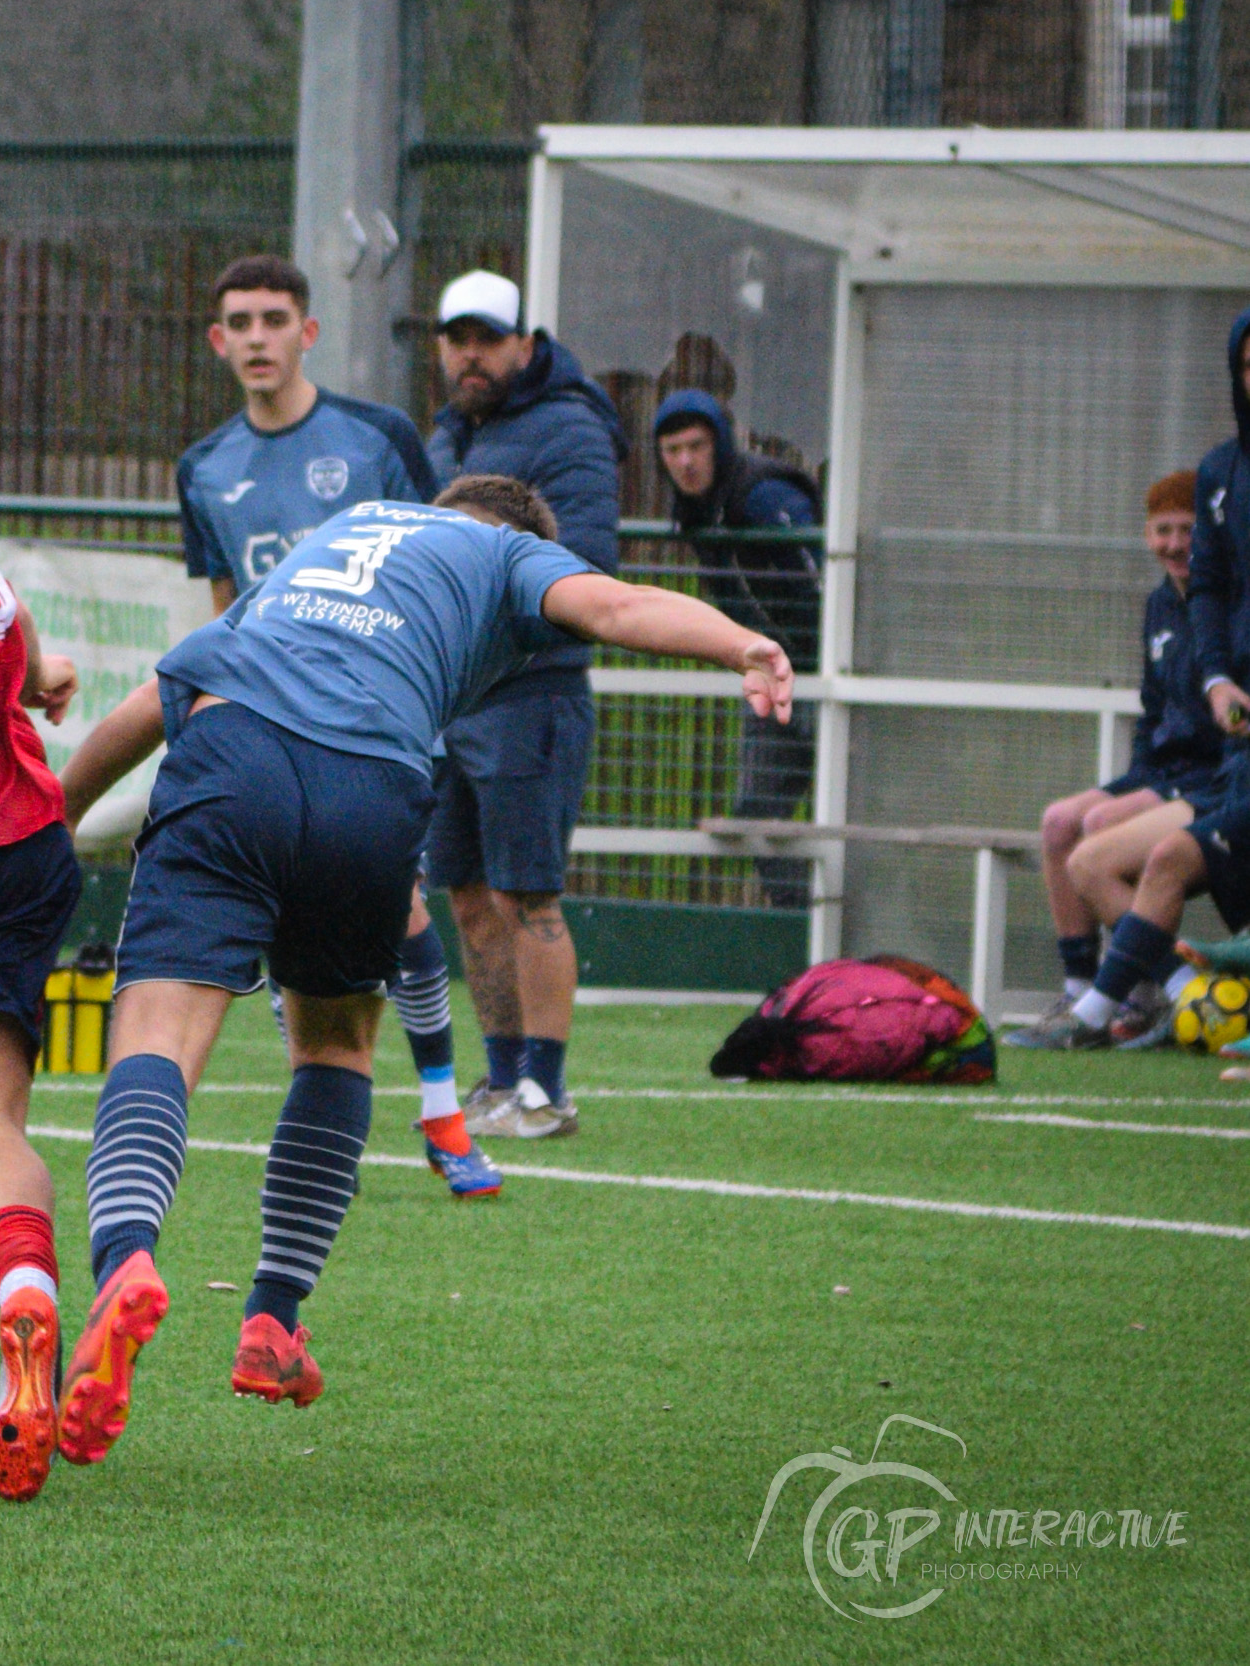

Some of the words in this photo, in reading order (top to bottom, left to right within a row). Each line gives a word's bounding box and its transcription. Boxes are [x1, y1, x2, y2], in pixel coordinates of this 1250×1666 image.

[289, 524, 426, 596] 3
[283, 593, 311, 605] W2
[316, 595, 405, 631] WINDOW
[293, 606, 377, 637] SYSTEMS
